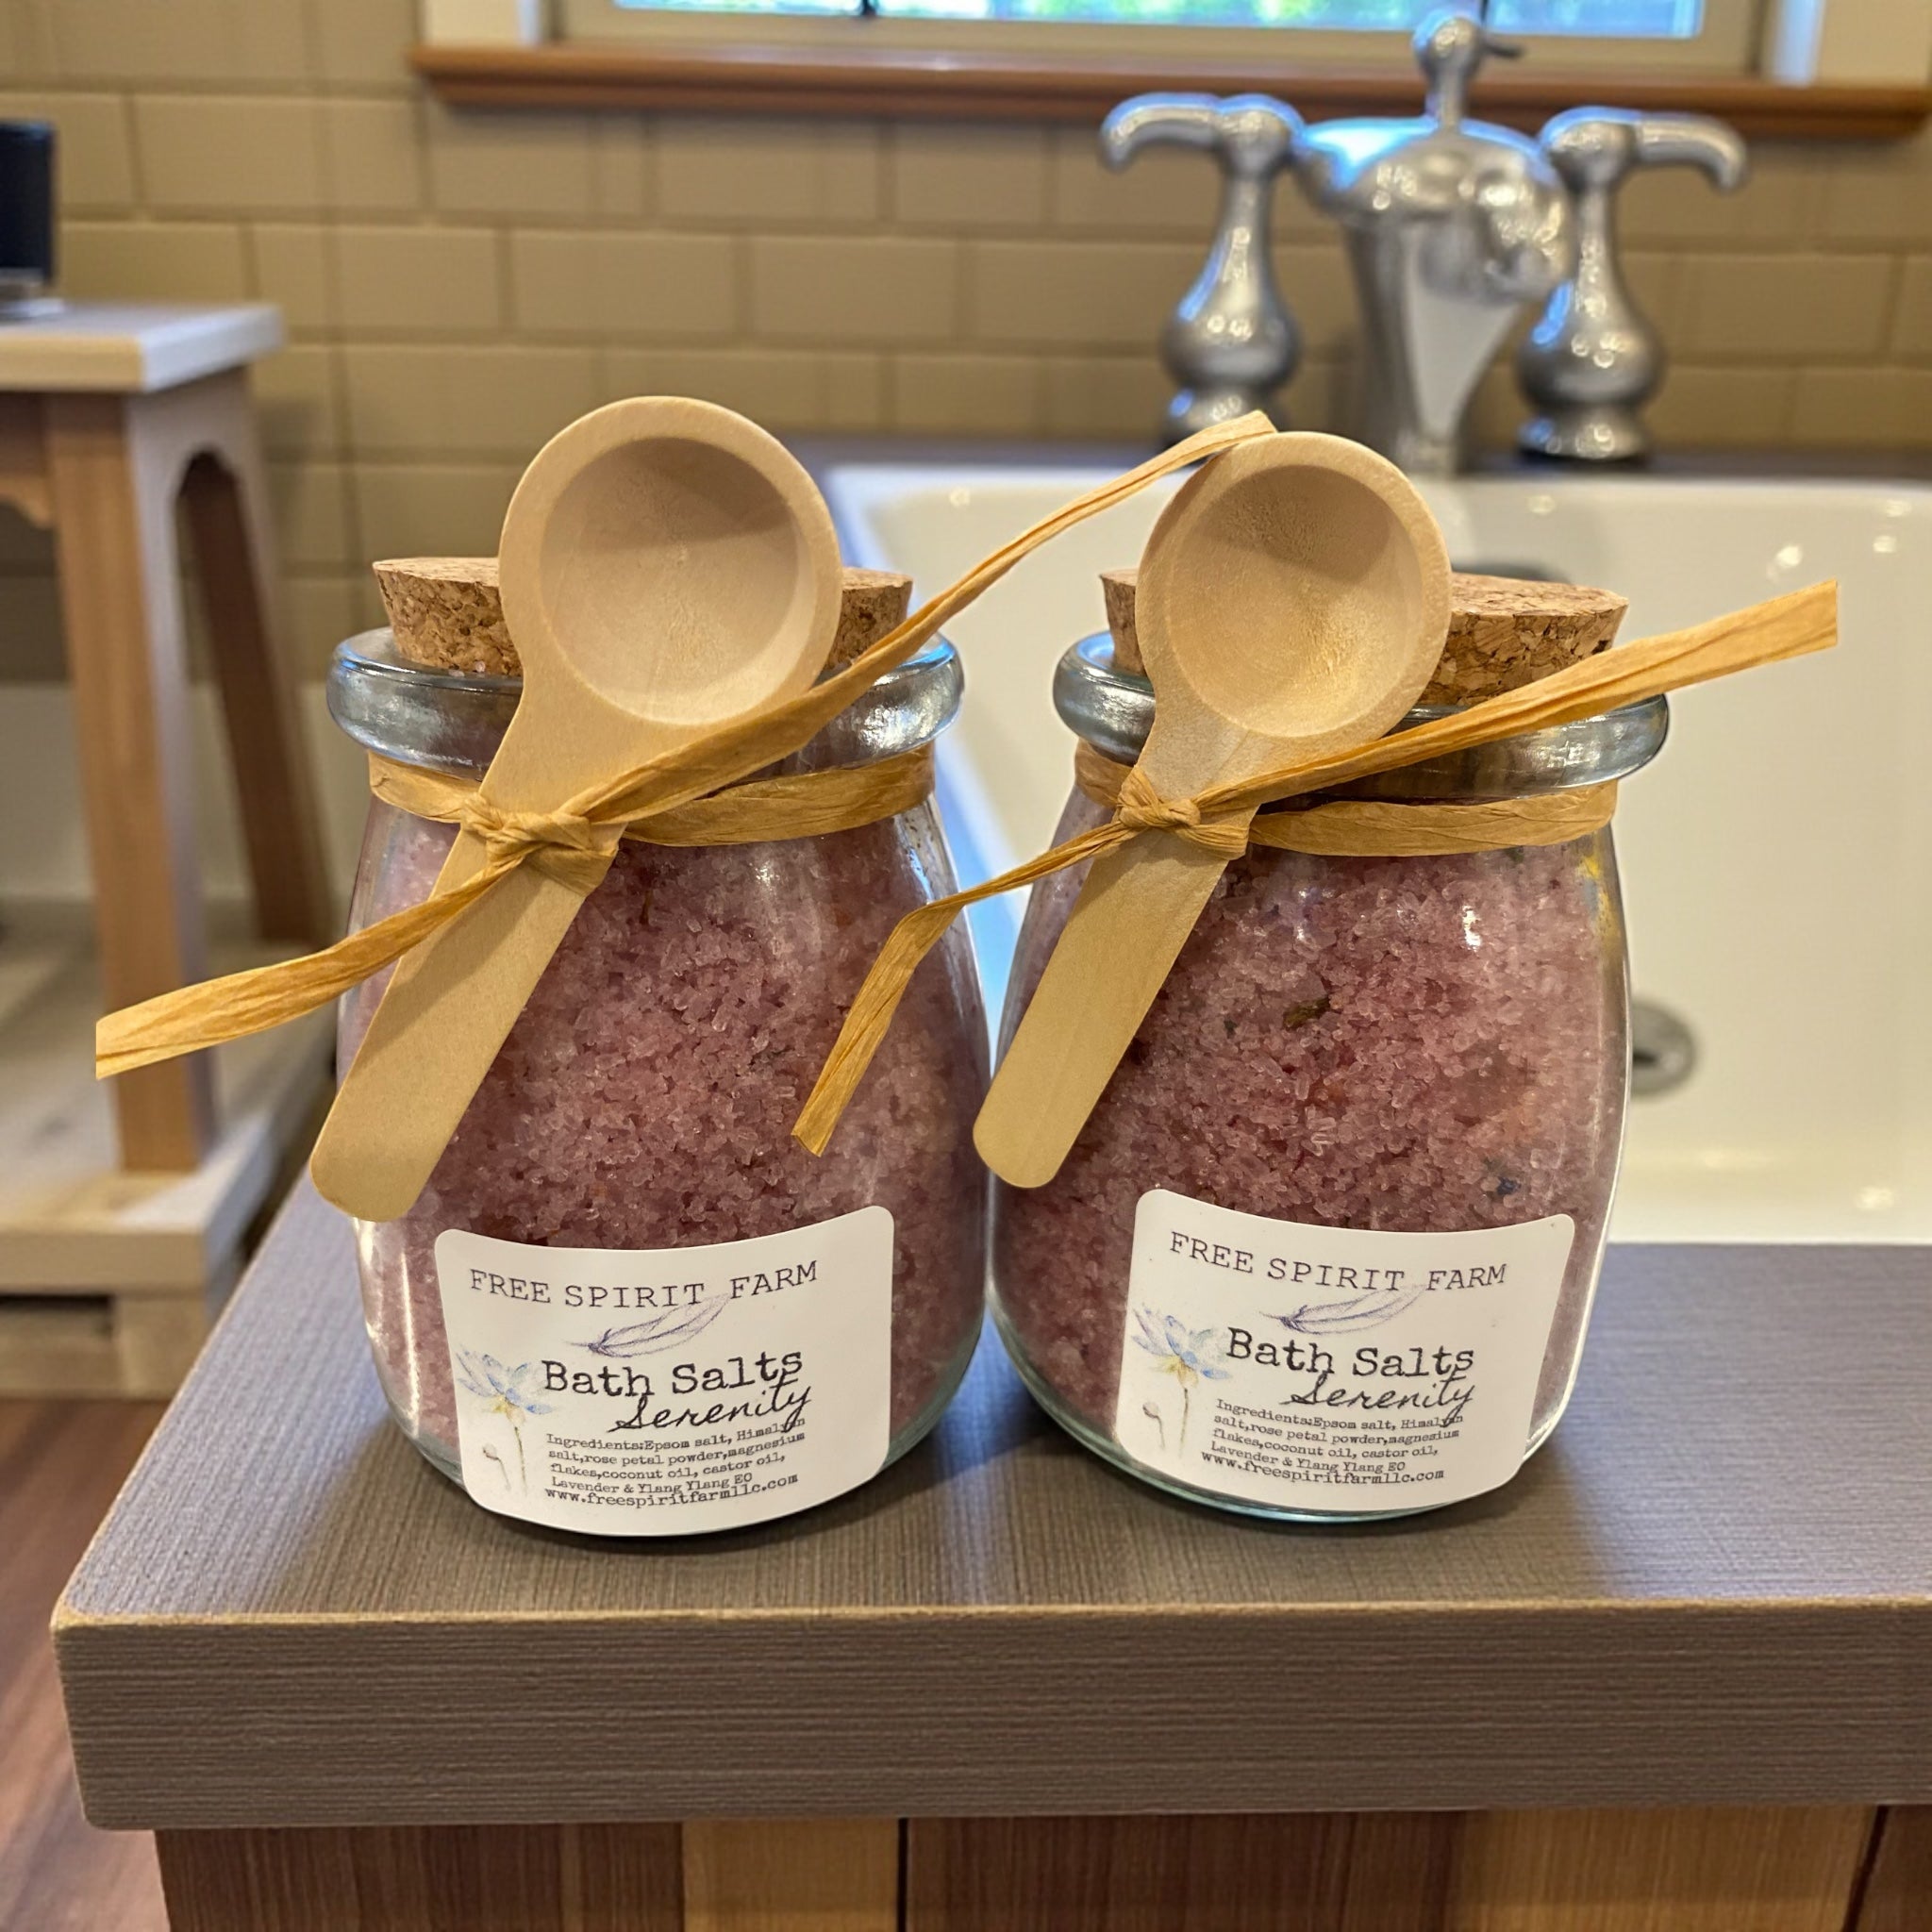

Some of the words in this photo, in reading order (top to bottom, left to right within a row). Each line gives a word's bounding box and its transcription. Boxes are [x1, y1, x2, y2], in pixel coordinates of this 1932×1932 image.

[1169, 1231, 1255, 1274] FREE
[1267, 1257, 1405, 1291] SPIRIT
[1426, 1263, 1508, 1291] FARM
[470, 1268, 551, 1305] FREE
[564, 1282, 705, 1308] SPIRIT
[729, 1259, 818, 1300] FARM
[1226, 1326, 1335, 1374] Bath
[1352, 1345, 1474, 1378] Salts
[541, 1359, 656, 1398] Bath
[671, 1351, 803, 1395] Salts
[606, 1376, 812, 1434] Serenity
[1278, 1370, 1476, 1428] Serenity
[694, 1433, 733, 1447] salt,
[1213, 1414, 1283, 1437] salt,rose
[1286, 1430, 1328, 1442] petal
[1360, 1420, 1396, 1430] salt,
[548, 1450, 618, 1465] salt,rose
[622, 1455, 665, 1468] petal
[667, 1467, 699, 1481] oil,
[702, 1459, 754, 1475] castor
[756, 1452, 786, 1467] oil,
[1201, 1451, 1445, 1485] www.freespiritfarmllc.com
[1211, 1441, 1279, 1465] Lavender
[1282, 1457, 1293, 1467] &
[1296, 1457, 1340, 1474] Ylang
[1342, 1461, 1384, 1474] Ylang
[1327, 1447, 1357, 1459] oil,
[1361, 1448, 1409, 1458] castor
[1411, 1445, 1439, 1456] oil,
[544, 1474, 799, 1508] www.freespiritfarmllc.com
[552, 1476, 620, 1493] Lavender
[623, 1483, 635, 1493] &
[638, 1483, 682, 1495] Ylang
[686, 1478, 730, 1491] Ylang
